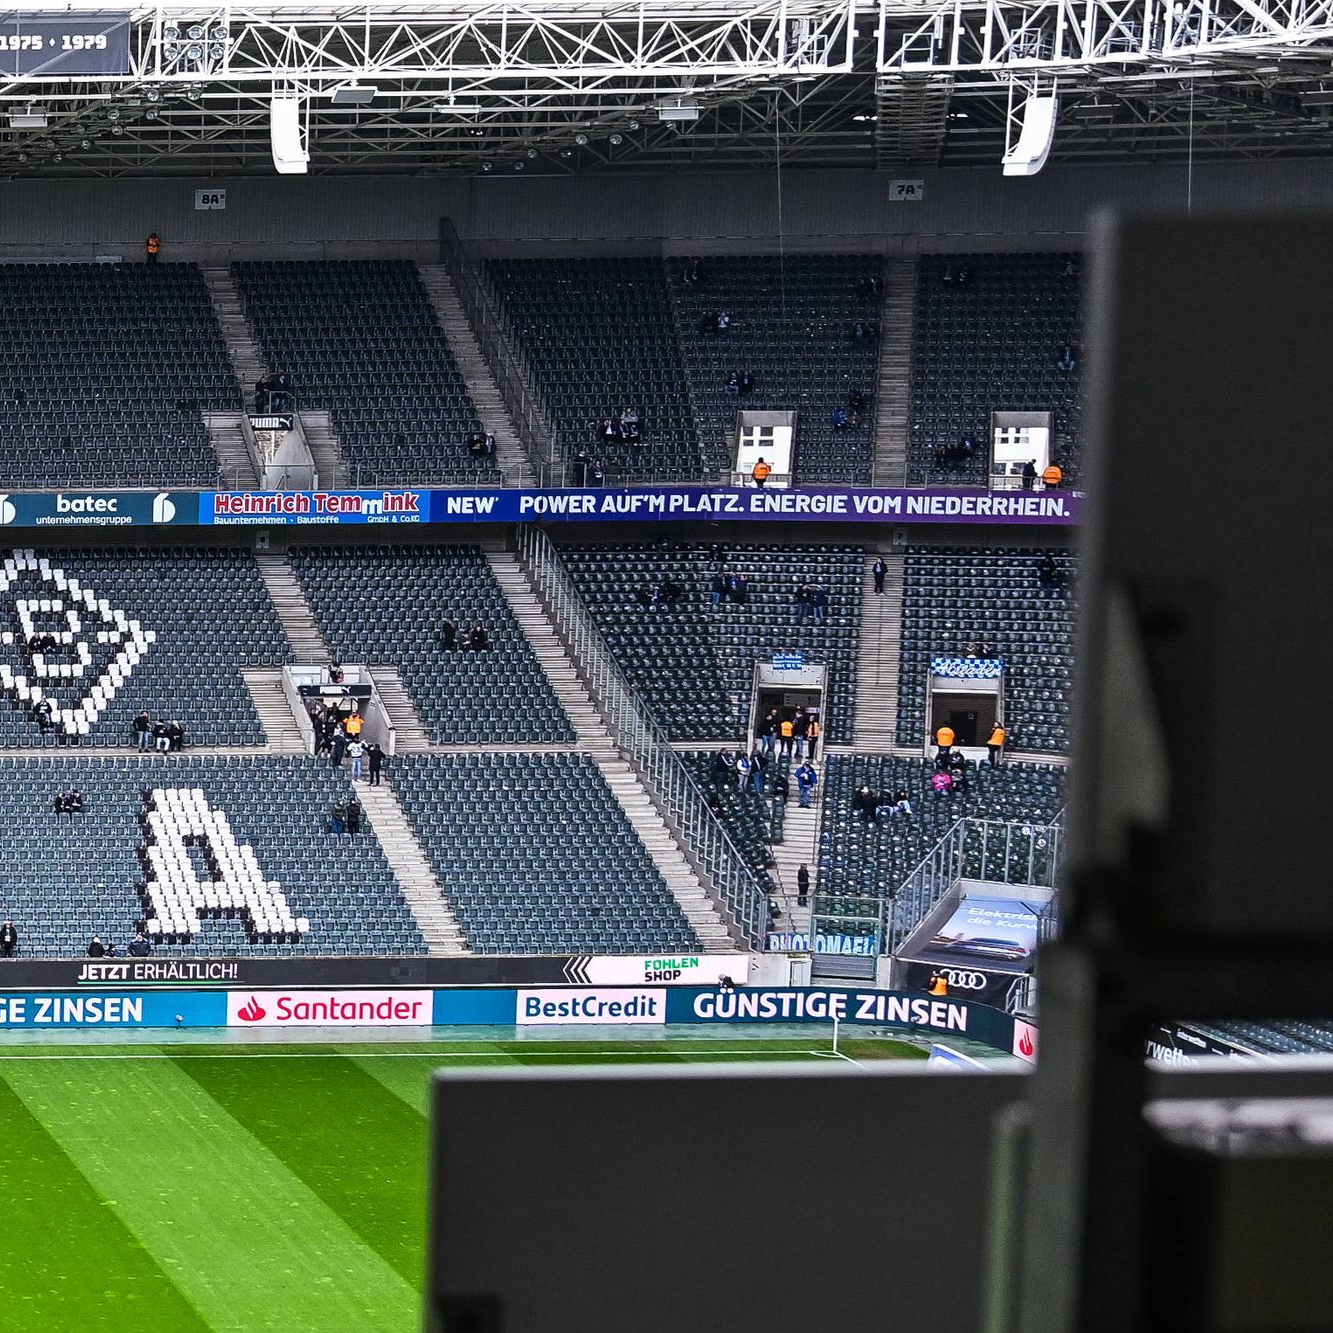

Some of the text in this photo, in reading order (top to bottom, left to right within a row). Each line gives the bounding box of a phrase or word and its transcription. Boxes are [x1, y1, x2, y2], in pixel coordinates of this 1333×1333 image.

[61, 34, 107, 50] 1979
[202, 194, 219, 205] 8A
[249, 417, 280, 428] PUMA
[56, 493, 118, 513] batec
[213, 493, 310, 514] Heinrich
[519, 495, 596, 514] POWER
[600, 494, 666, 513] AUF'M
[669, 494, 745, 512] PLATZ.
[750, 494, 848, 514] ENERGIE
[852, 495, 901, 514] VOM
[906, 495, 1071, 517] NIEDERRHEIN.
[35, 515, 133, 526] unternehmensgruppe
[213, 515, 340, 525] Bauunternehmen Baustoffe
[366, 515, 390, 523] GmbH
[77, 962, 239, 980] JETZT ERHÄLTLICH!
[644, 957, 699, 971] FOHLEN
[644, 969, 682, 982] SHOP
[33, 997, 143, 1023] ZINSEN
[276, 996, 422, 1022] Santander
[525, 994, 658, 1018] BestCredit
[693, 986, 968, 1032] GÜNSTIGE ZINSEN
